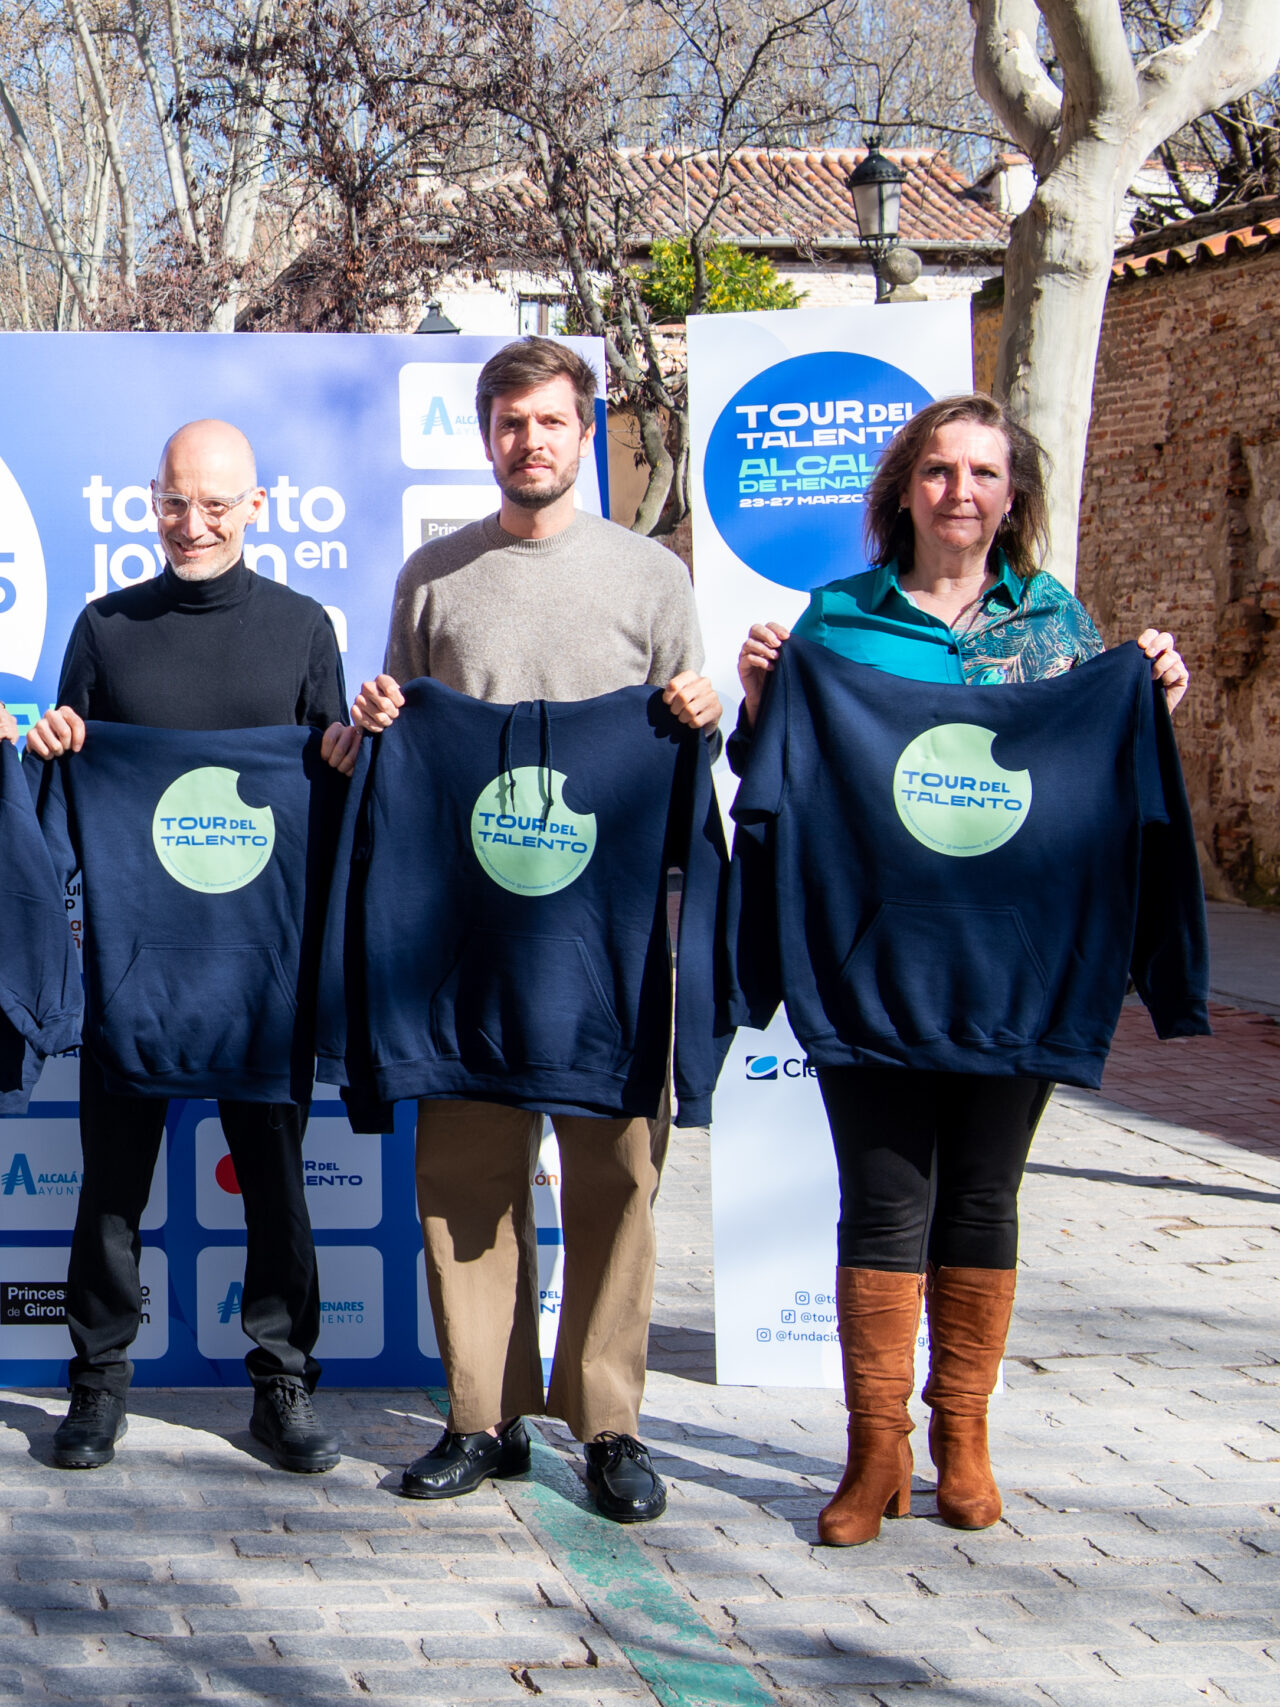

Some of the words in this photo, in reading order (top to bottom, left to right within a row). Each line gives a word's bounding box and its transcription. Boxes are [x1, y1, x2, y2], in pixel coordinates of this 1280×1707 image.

[735, 400, 865, 429] TOUR
[868, 402, 917, 423] DEL
[736, 425, 904, 450] TALENT
[738, 453, 882, 479] ALCAL
[739, 478, 777, 494] DE
[739, 496, 795, 508] 23-27
[294, 540, 348, 569] en
[902, 770, 977, 791] TOUR
[979, 780, 1011, 793] DEL
[901, 789, 1023, 811] TALENTO
[160, 816, 227, 831] TOUR
[229, 819, 256, 830] DEL
[549, 822, 578, 836] DEL
[160, 835, 268, 847] TALENTO
[478, 831, 588, 854] TALENTO
[318, 1162, 340, 1171] DEL
[38, 1171, 78, 1184] ALCALÁ
[304, 1175, 363, 1186] ENTO
[7, 1286, 66, 1300] Princes
[539, 1290, 561, 1299] DEL
[7, 1306, 21, 1317] de
[24, 1303, 66, 1317] Giron
